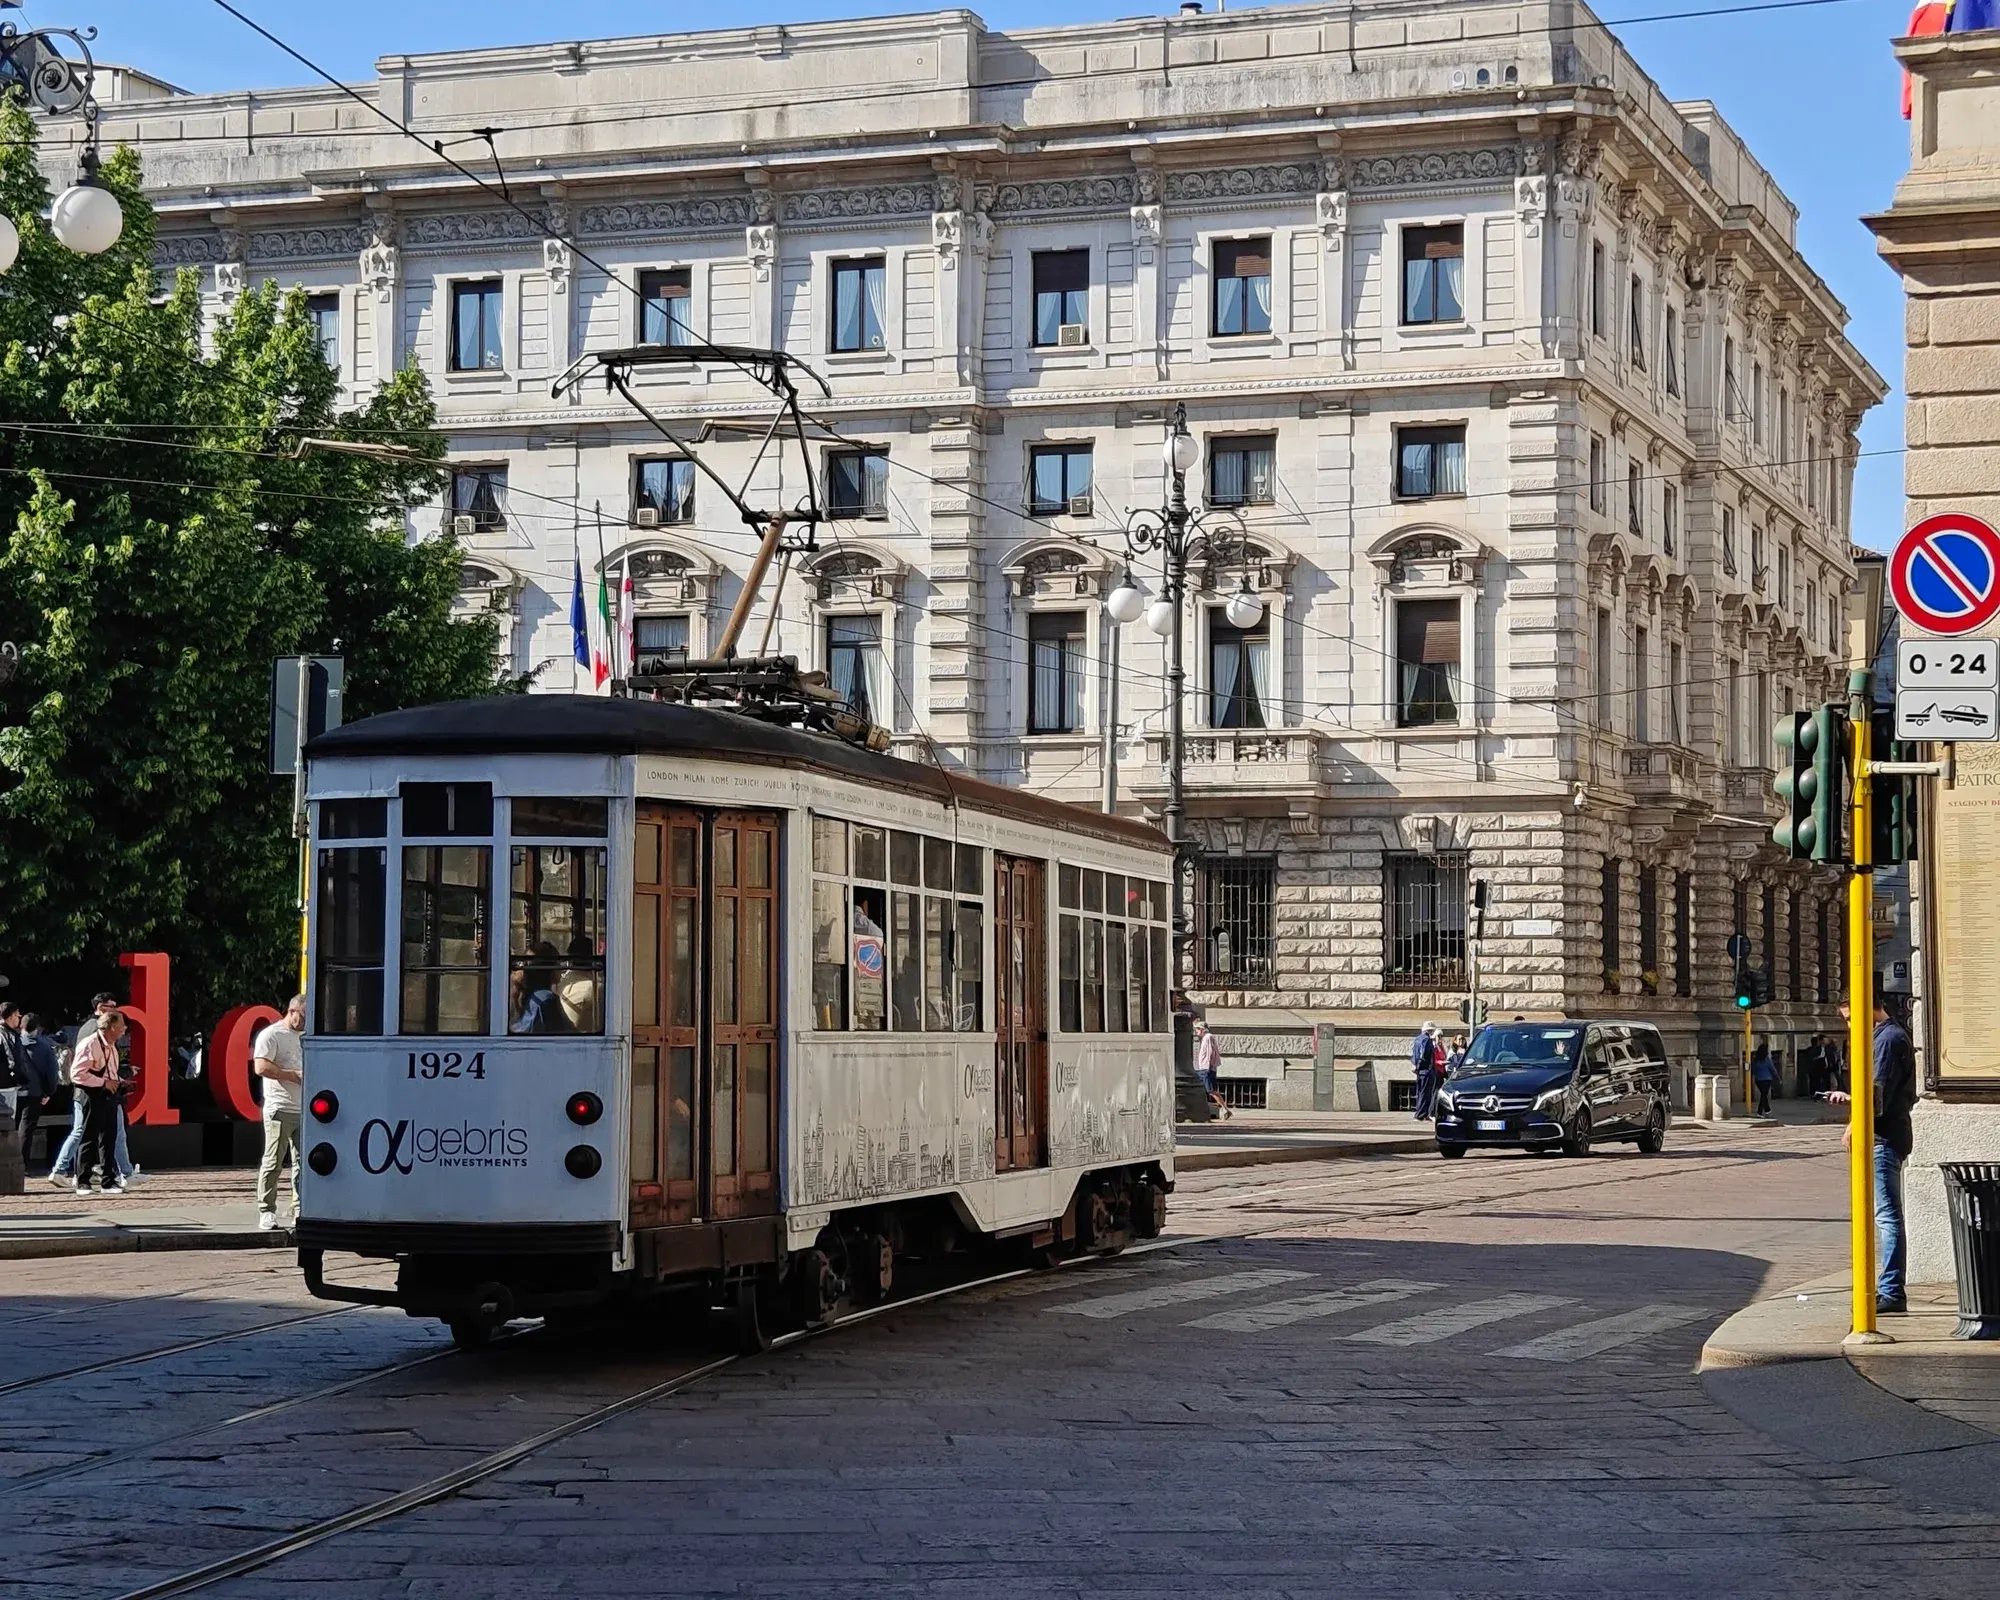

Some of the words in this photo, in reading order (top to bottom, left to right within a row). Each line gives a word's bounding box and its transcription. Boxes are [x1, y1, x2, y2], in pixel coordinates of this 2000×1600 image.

[1909, 653, 1927, 675] 0
[1949, 653, 1987, 675] 24
[647, 770, 679, 781] LONDON
[683, 773, 706, 784] MILAN
[711, 776, 729, 786] ROME
[734, 778, 760, 788] ZURICH
[407, 1052, 486, 1080] 1924
[439, 1157, 528, 1168] INVESTMENTS
